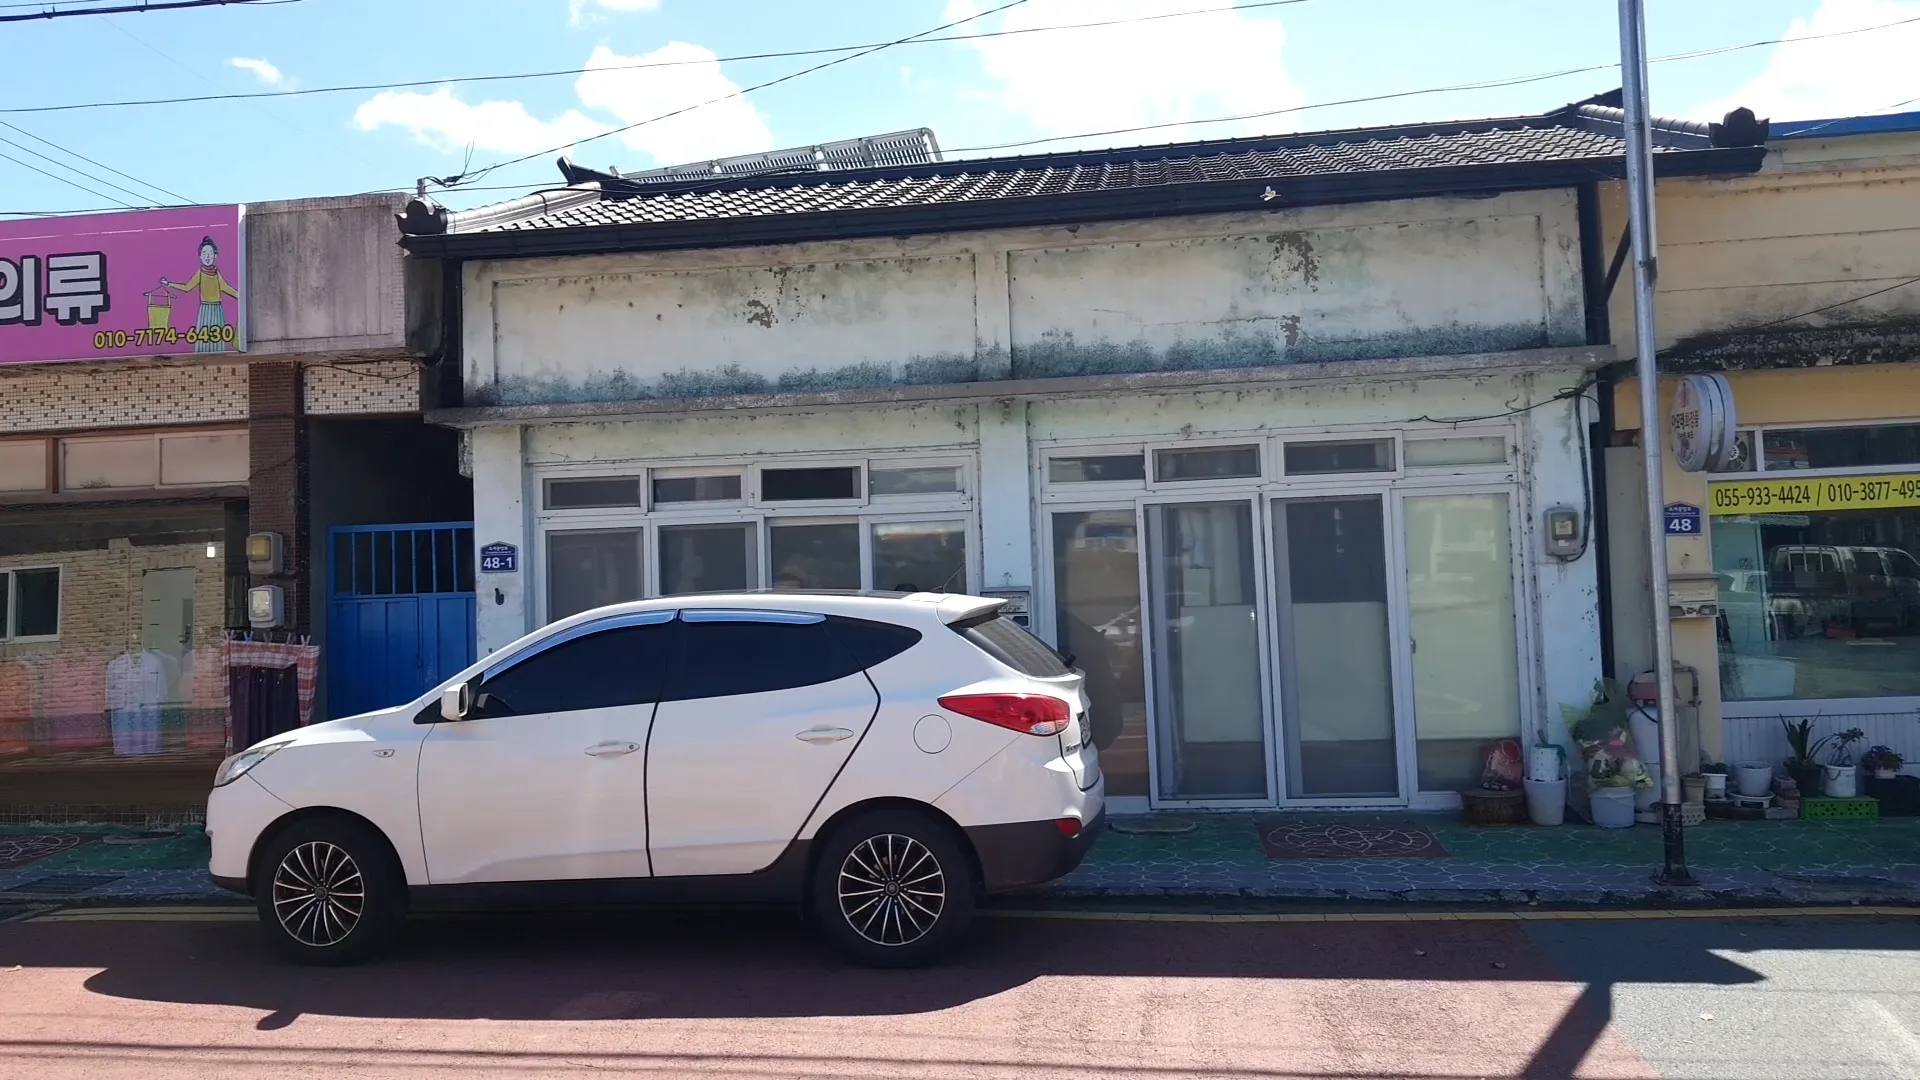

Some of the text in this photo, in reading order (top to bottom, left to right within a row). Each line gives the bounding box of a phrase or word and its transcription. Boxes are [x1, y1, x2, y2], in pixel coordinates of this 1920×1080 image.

[94, 324, 234, 349] 010-7174-6430
[1715, 484, 1811, 507] 055-933-4424
[1816, 482, 1822, 506] /
[1669, 518, 1692, 531] 48
[483, 557, 512, 569] 48-1
